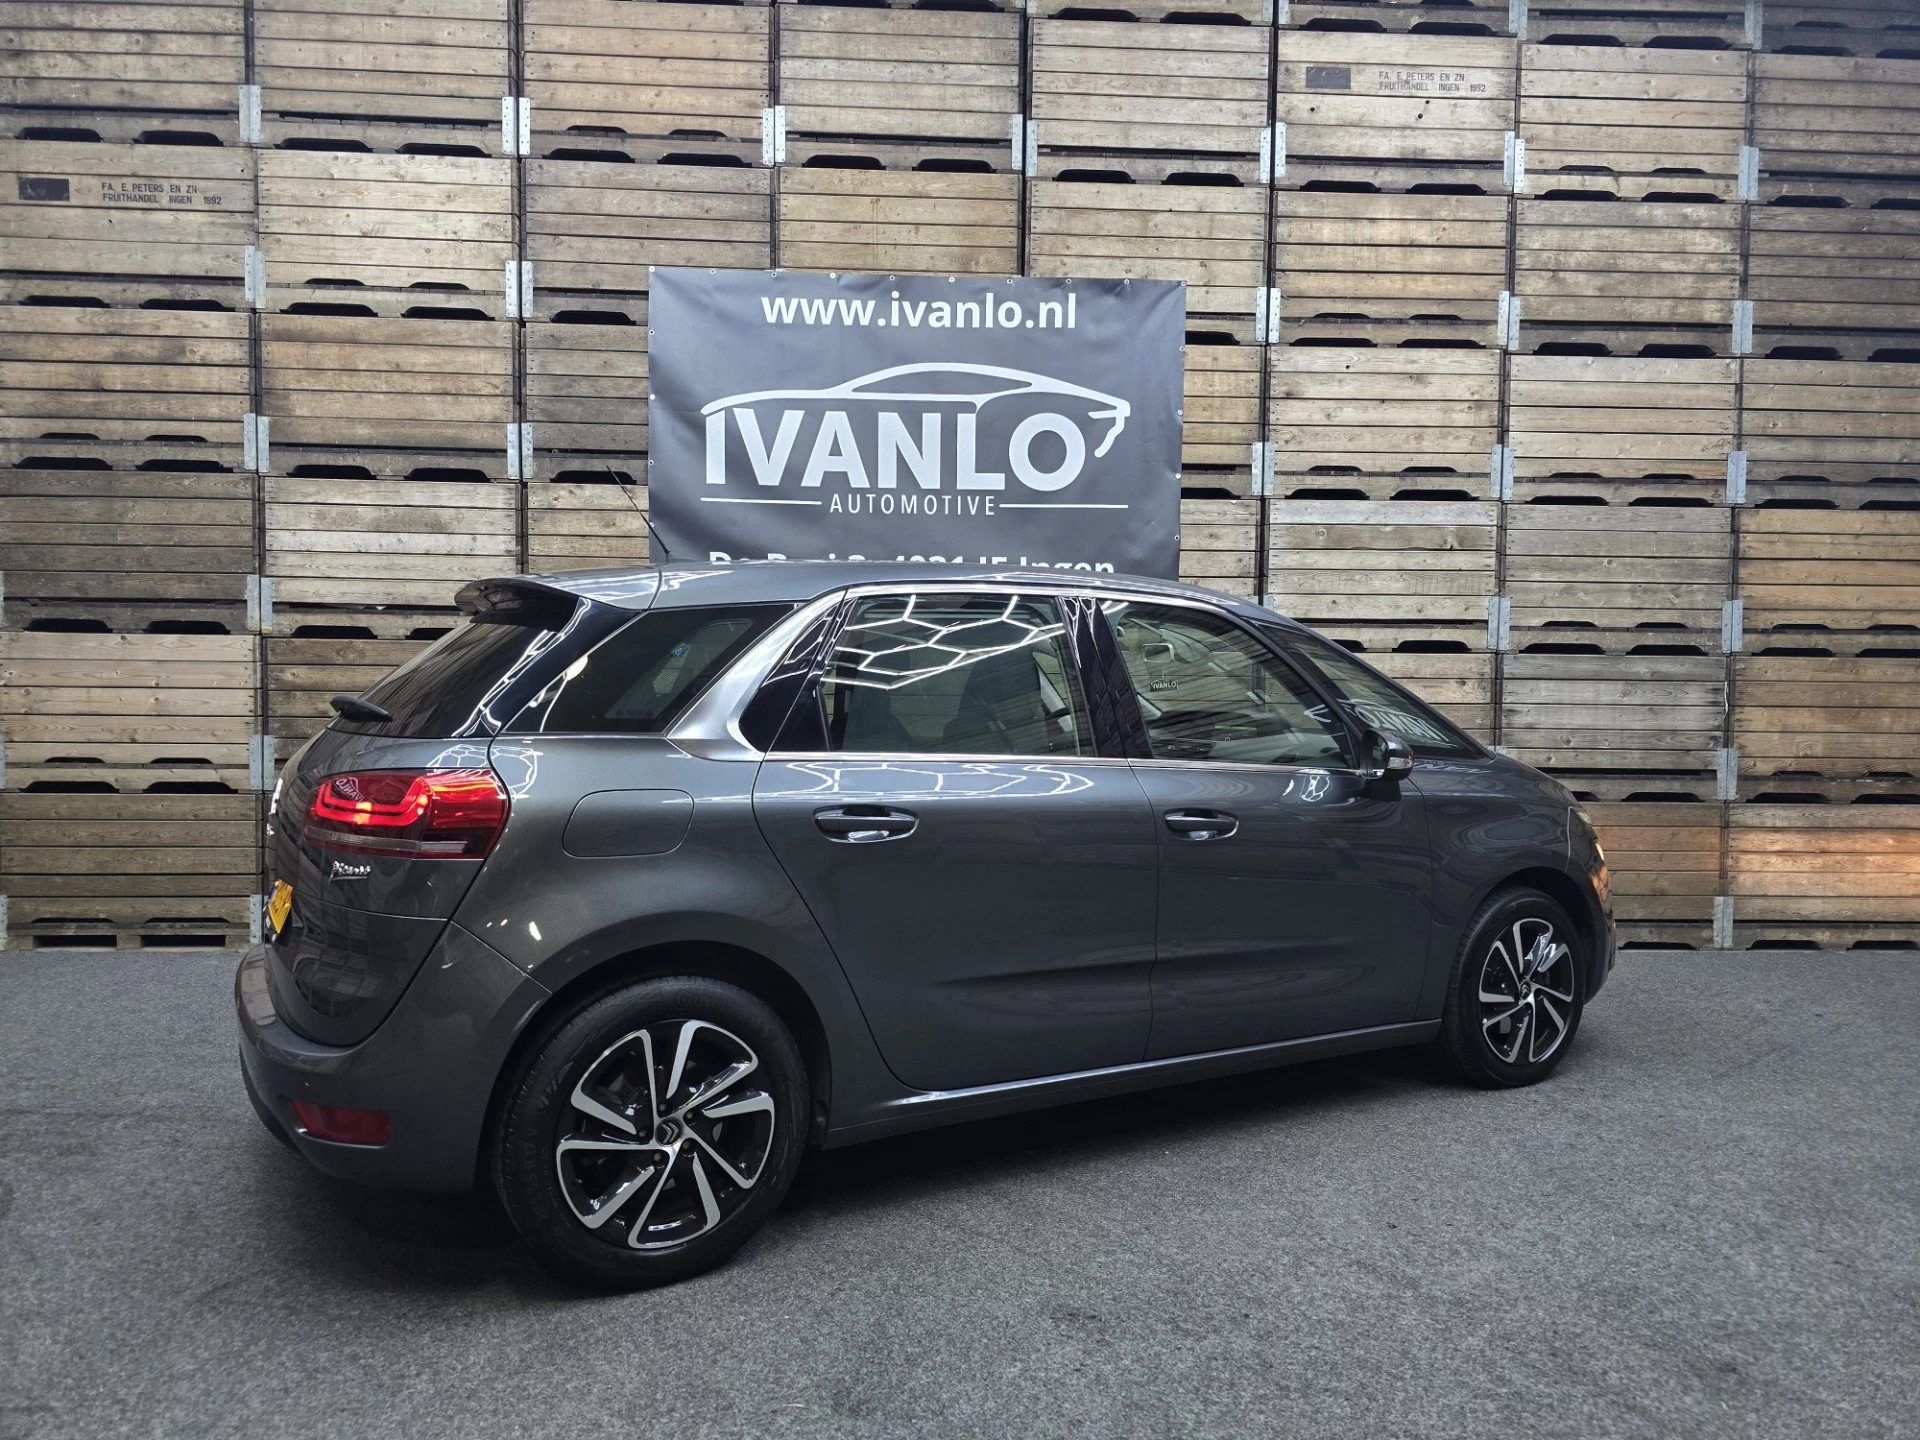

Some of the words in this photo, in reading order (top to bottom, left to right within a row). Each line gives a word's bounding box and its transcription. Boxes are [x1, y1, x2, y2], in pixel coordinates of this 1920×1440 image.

[1406, 72, 1435, 81] PETERS
[1440, 73, 1450, 81] EN
[1454, 73, 1465, 82] ZN
[1379, 81, 1429, 91] FRUITHANDEL
[1438, 83, 1460, 92] INGEN
[1469, 84, 1486, 93] 1992
[132, 183, 165, 193] PETERS
[170, 184, 181, 193] EN
[186, 184, 198, 194] ZN
[102, 193, 159, 204] FRUITHANDEL
[168, 195, 192, 205] INGEN
[203, 196, 222, 205] 1992
[761, 291, 1077, 329] www.ivanlo.nl
[705, 407, 1087, 492] IVANLO
[829, 494, 996, 517] AUTOMOTIVE
